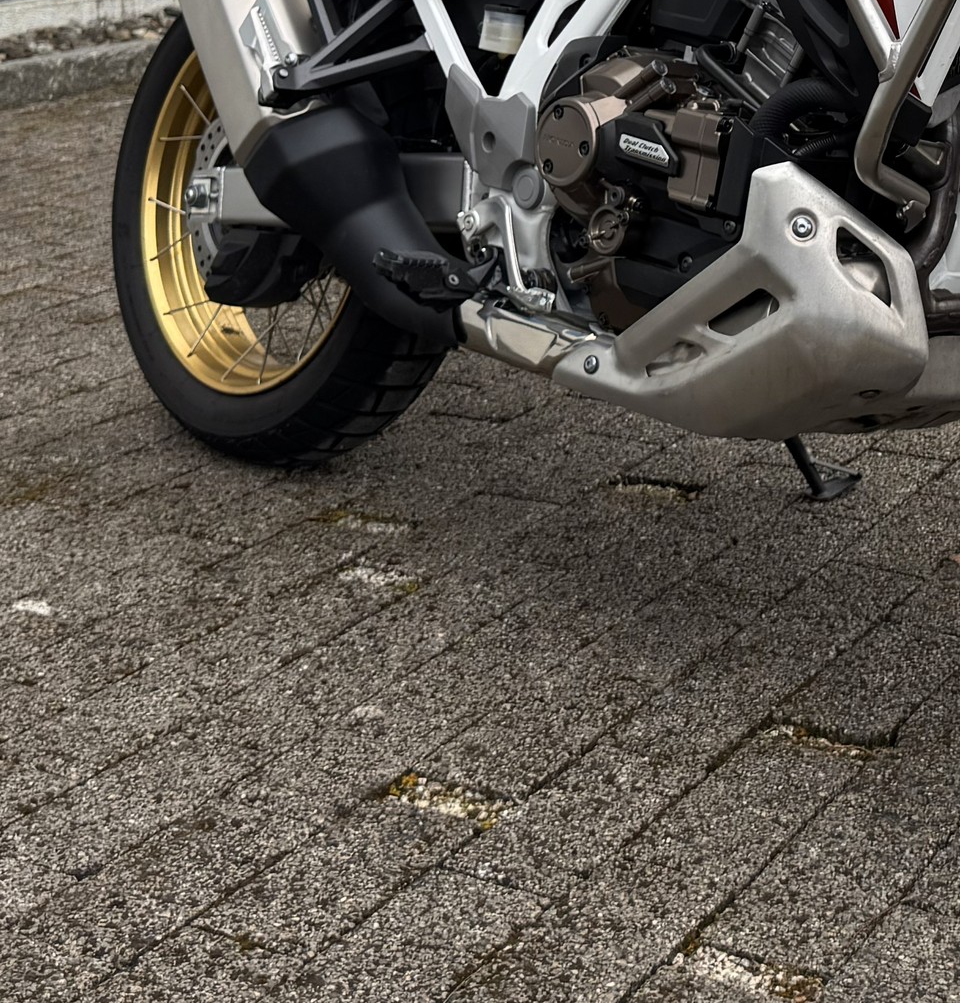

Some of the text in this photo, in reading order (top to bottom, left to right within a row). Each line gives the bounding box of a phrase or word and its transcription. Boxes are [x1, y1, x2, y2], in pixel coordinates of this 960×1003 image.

[622, 137, 659, 153] Dual Clutch
[624, 145, 667, 163] Transmission
